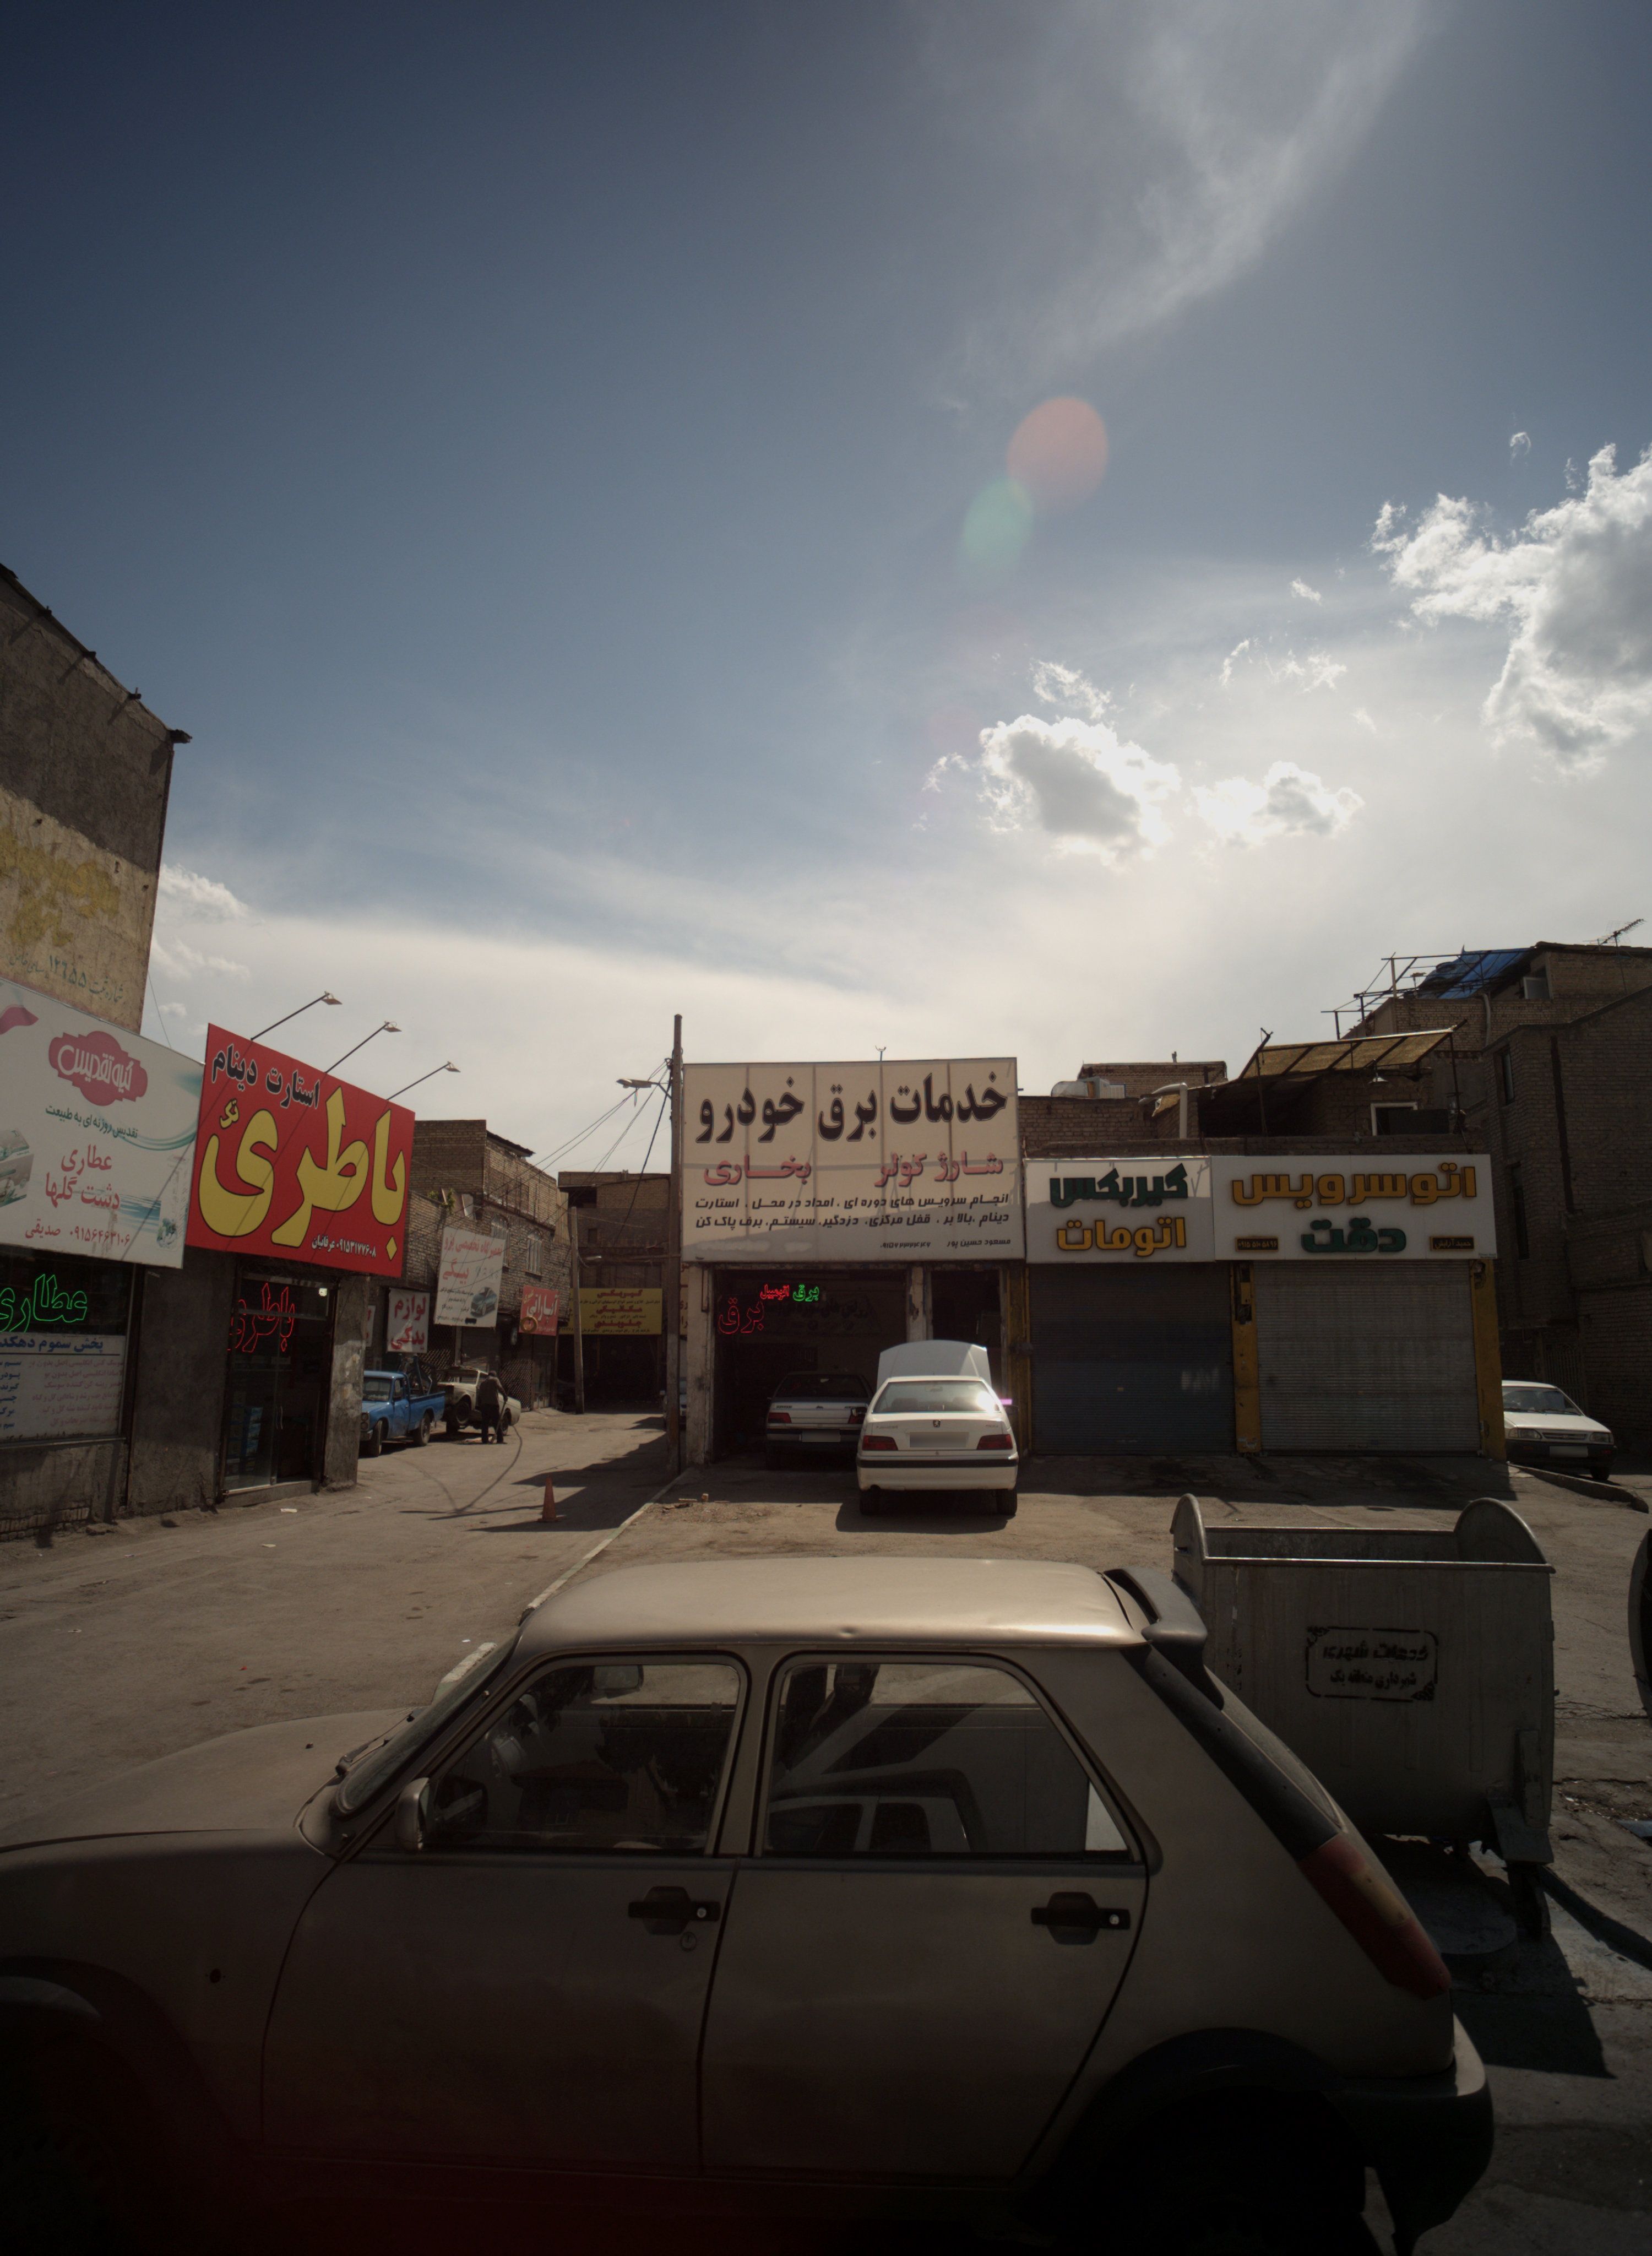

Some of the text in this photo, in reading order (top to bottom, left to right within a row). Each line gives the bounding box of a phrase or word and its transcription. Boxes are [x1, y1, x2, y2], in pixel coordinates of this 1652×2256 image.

[58, 1045, 115, 1084] تقدیس
[211, 1044, 319, 1109] استارت دینام
[45, 1106, 73, 1122] طبیعت
[74, 1112, 82, 1127] به
[695, 1071, 1008, 1143] خدمات برق خودرو
[83, 1114, 93, 1128] ای
[61, 1145, 112, 1175] عطاری
[704, 1153, 812, 1186] بخاری
[874, 1149, 1003, 1187] شارژ کولر
[198, 1086, 406, 1261] باطری
[1231, 1163, 1477, 1209] اتوسرویس
[45, 1173, 120, 1210] دشت گلها
[695, 1194, 1009, 1210] انجام سرویس های دوره ای امداد در محل استارت
[25, 1218, 61, 1239] صدیقی
[695, 1217, 711, 1228] کن
[714, 1217, 736, 1230] پاک
[739, 1217, 763, 1227] برف
[906, 1214, 931, 1226] قفل
[979, 1212, 1009, 1227] دینام
[1057, 1217, 1186, 1257] اتومات
[1302, 1217, 1406, 1253] دقت
[793, 1282, 820, 1302] برق
[394, 1295, 426, 1321] لوازم
[718, 1297, 765, 1335] برق
[0, 1335, 103, 1353] پخش سموم دهکد
[390, 1326, 425, 1350] یدکی
